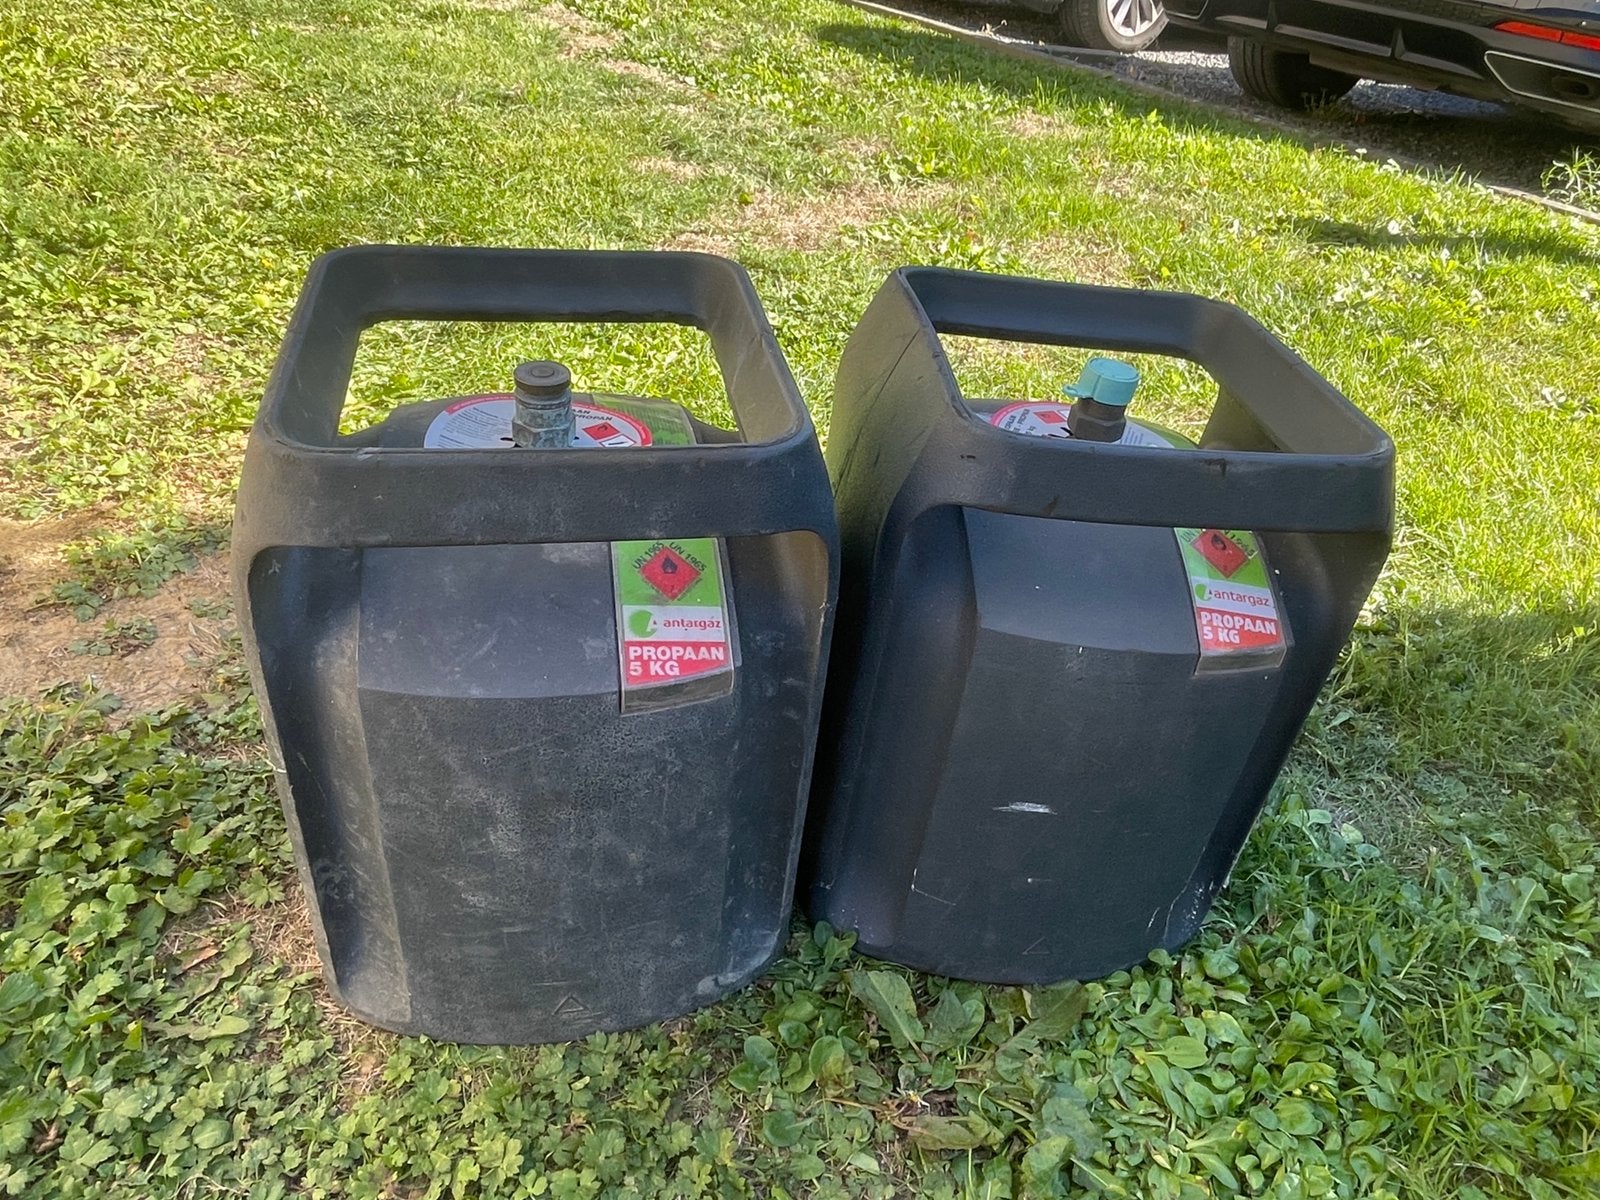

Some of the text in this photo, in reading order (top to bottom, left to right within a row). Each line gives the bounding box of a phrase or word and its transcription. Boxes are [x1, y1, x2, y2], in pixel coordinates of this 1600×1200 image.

[631, 542, 665, 570] UN 1965
[669, 541, 708, 572] UN 1965
[1214, 589, 1271, 607] antargaz
[663, 618, 722, 631] antargaz
[1200, 611, 1277, 635] PROPAAN
[1203, 626, 1241, 644] 5 KG
[628, 645, 725, 661] PROPAAN
[629, 660, 680, 676] 5 KG
